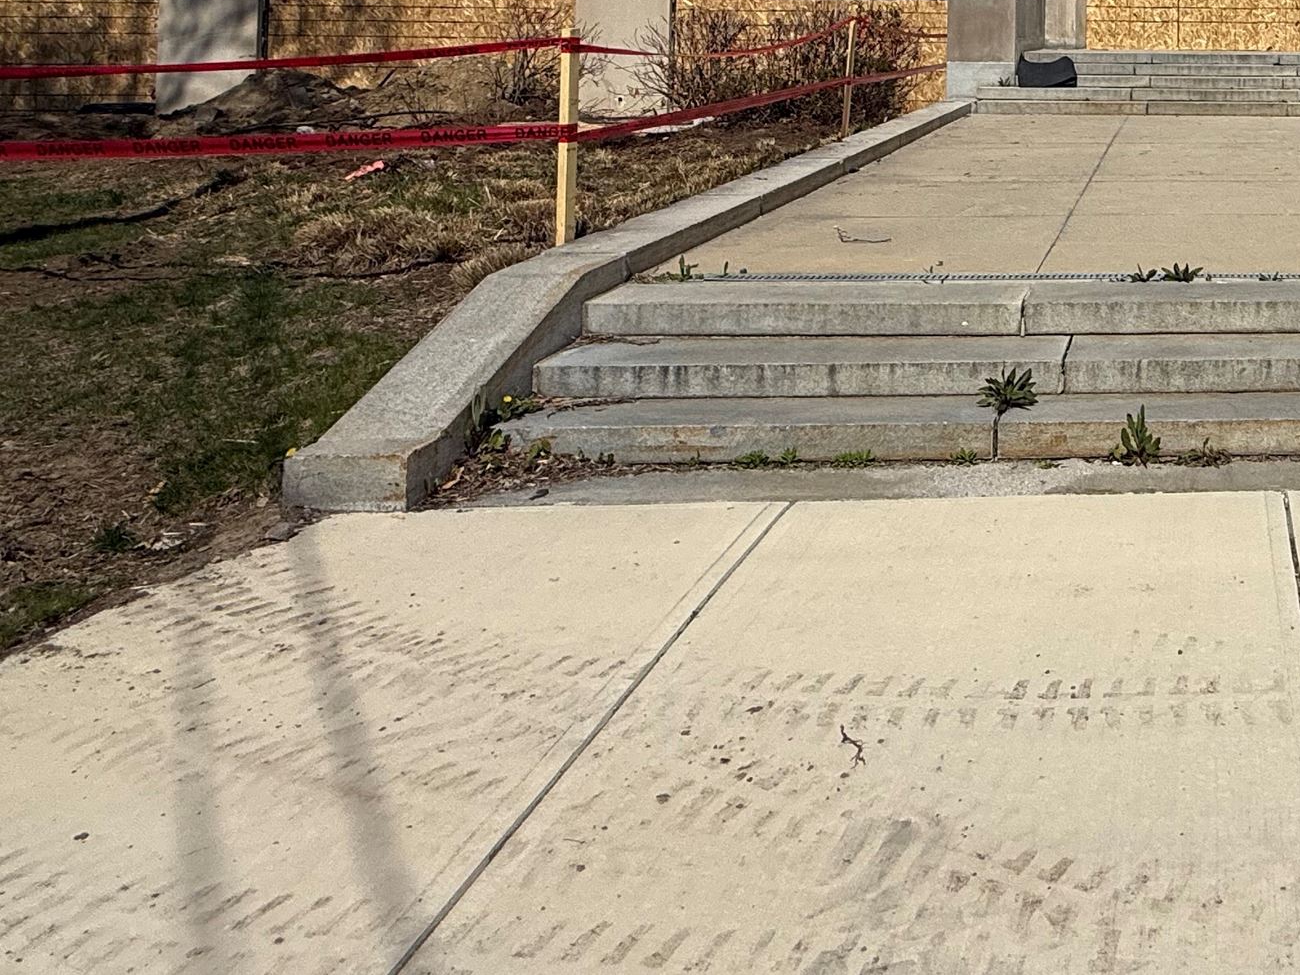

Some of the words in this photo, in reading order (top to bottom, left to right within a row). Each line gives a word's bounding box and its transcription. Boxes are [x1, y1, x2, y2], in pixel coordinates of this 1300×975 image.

[36, 143, 106, 156] DANGER
[132, 140, 201, 155] DANGER
[228, 136, 299, 152] DANGER
[325, 132, 392, 147] DANGER
[420, 129, 488, 143] DANGER
